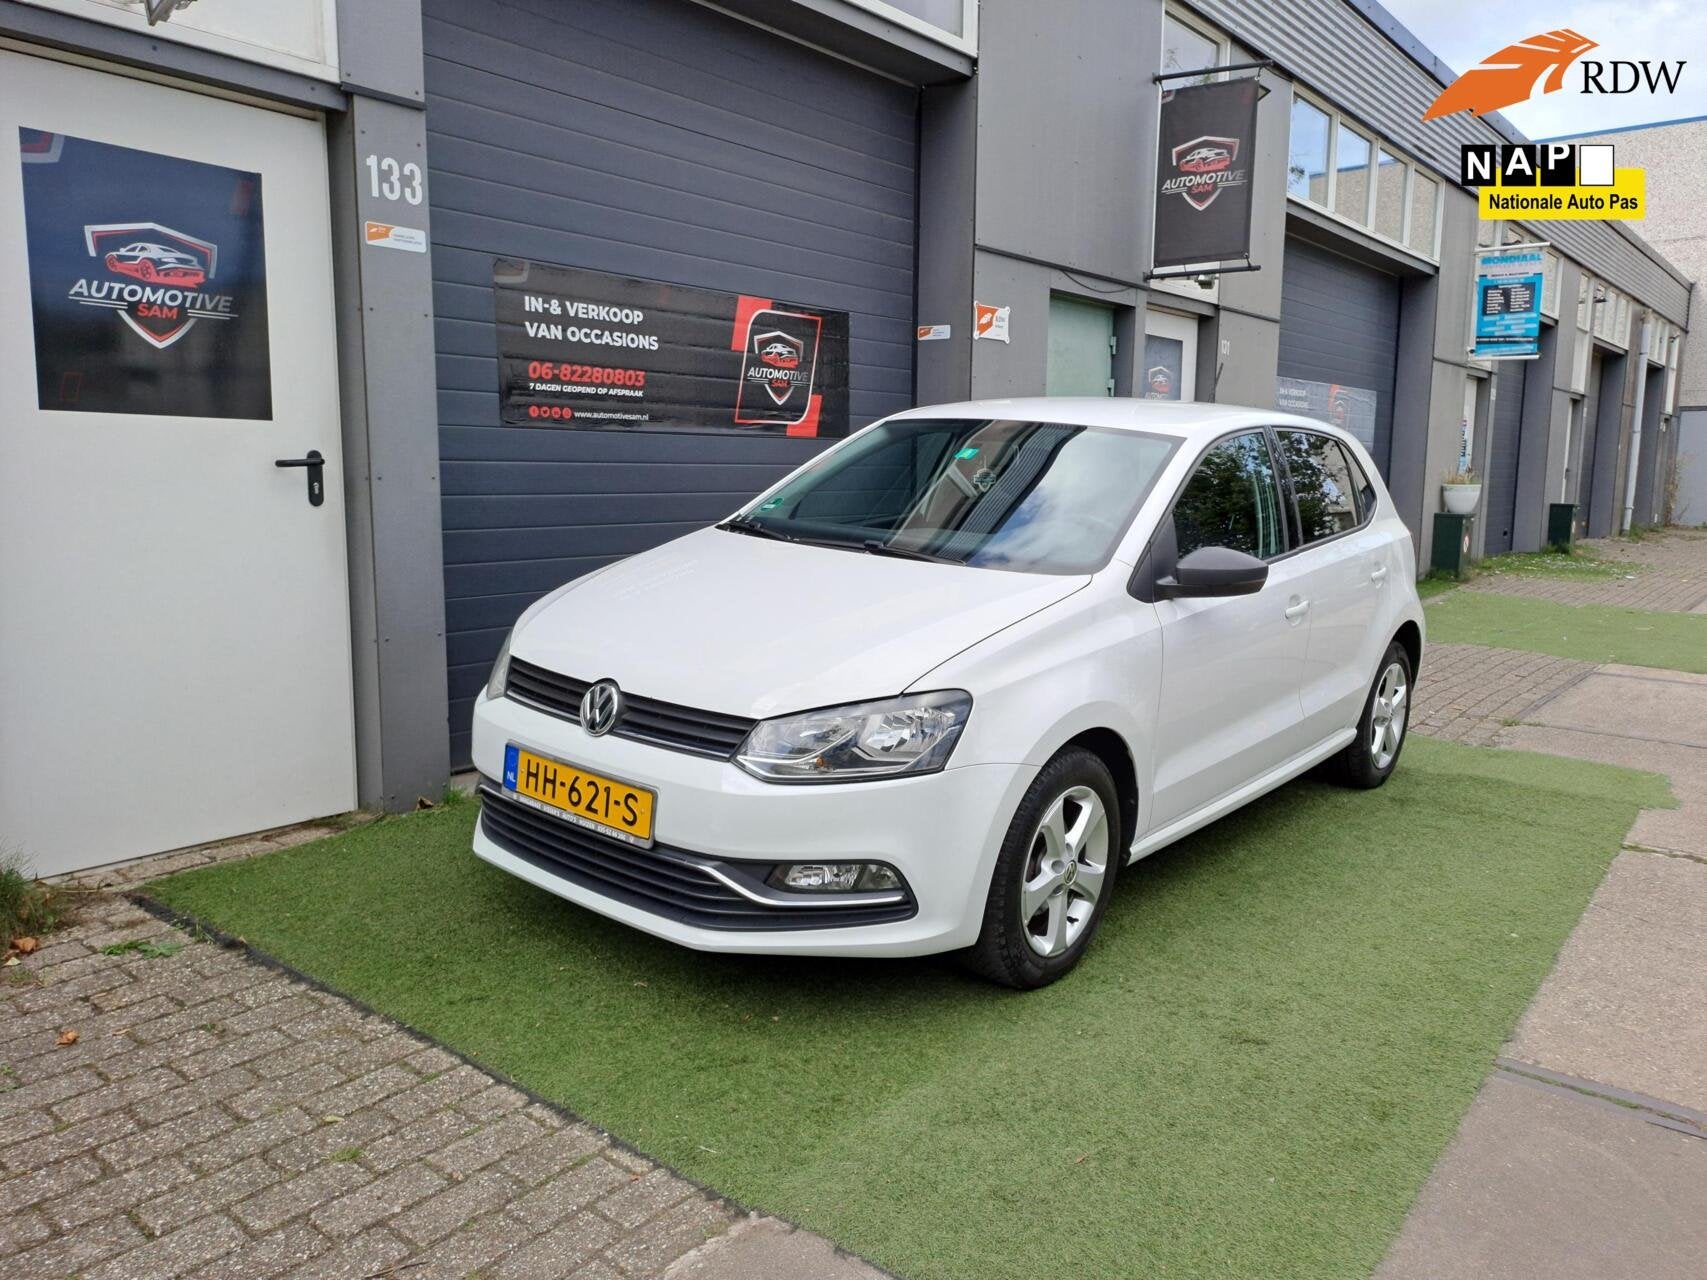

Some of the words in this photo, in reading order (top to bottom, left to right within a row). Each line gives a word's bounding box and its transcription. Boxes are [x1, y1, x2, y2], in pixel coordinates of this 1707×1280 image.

[366, 154, 423, 206] 133
[1161, 169, 1246, 191] AUTOMOTIVE
[1191, 183, 1214, 194] SAM
[68, 278, 233, 312] AUTOMOTIVE
[137, 303, 178, 320] SAM
[524, 295, 562, 315] IN-&
[565, 301, 644, 325] VERKOOP
[525, 321, 563, 341] VAN
[566, 326, 660, 351] OCCASIONS
[528, 360, 646, 387] 06-82280803
[747, 366, 809, 382] AUTOMOTIVE
[535, 383, 561, 392] DAGEN
[562, 385, 596, 394] GEOPEND
[597, 387, 608, 395] OP
[608, 388, 644, 397] AFSPRAAK
[574, 410, 649, 421] www.automotivesam.nl
[506, 771, 516, 783] NL
[525, 758, 639, 827] HH-621-S
